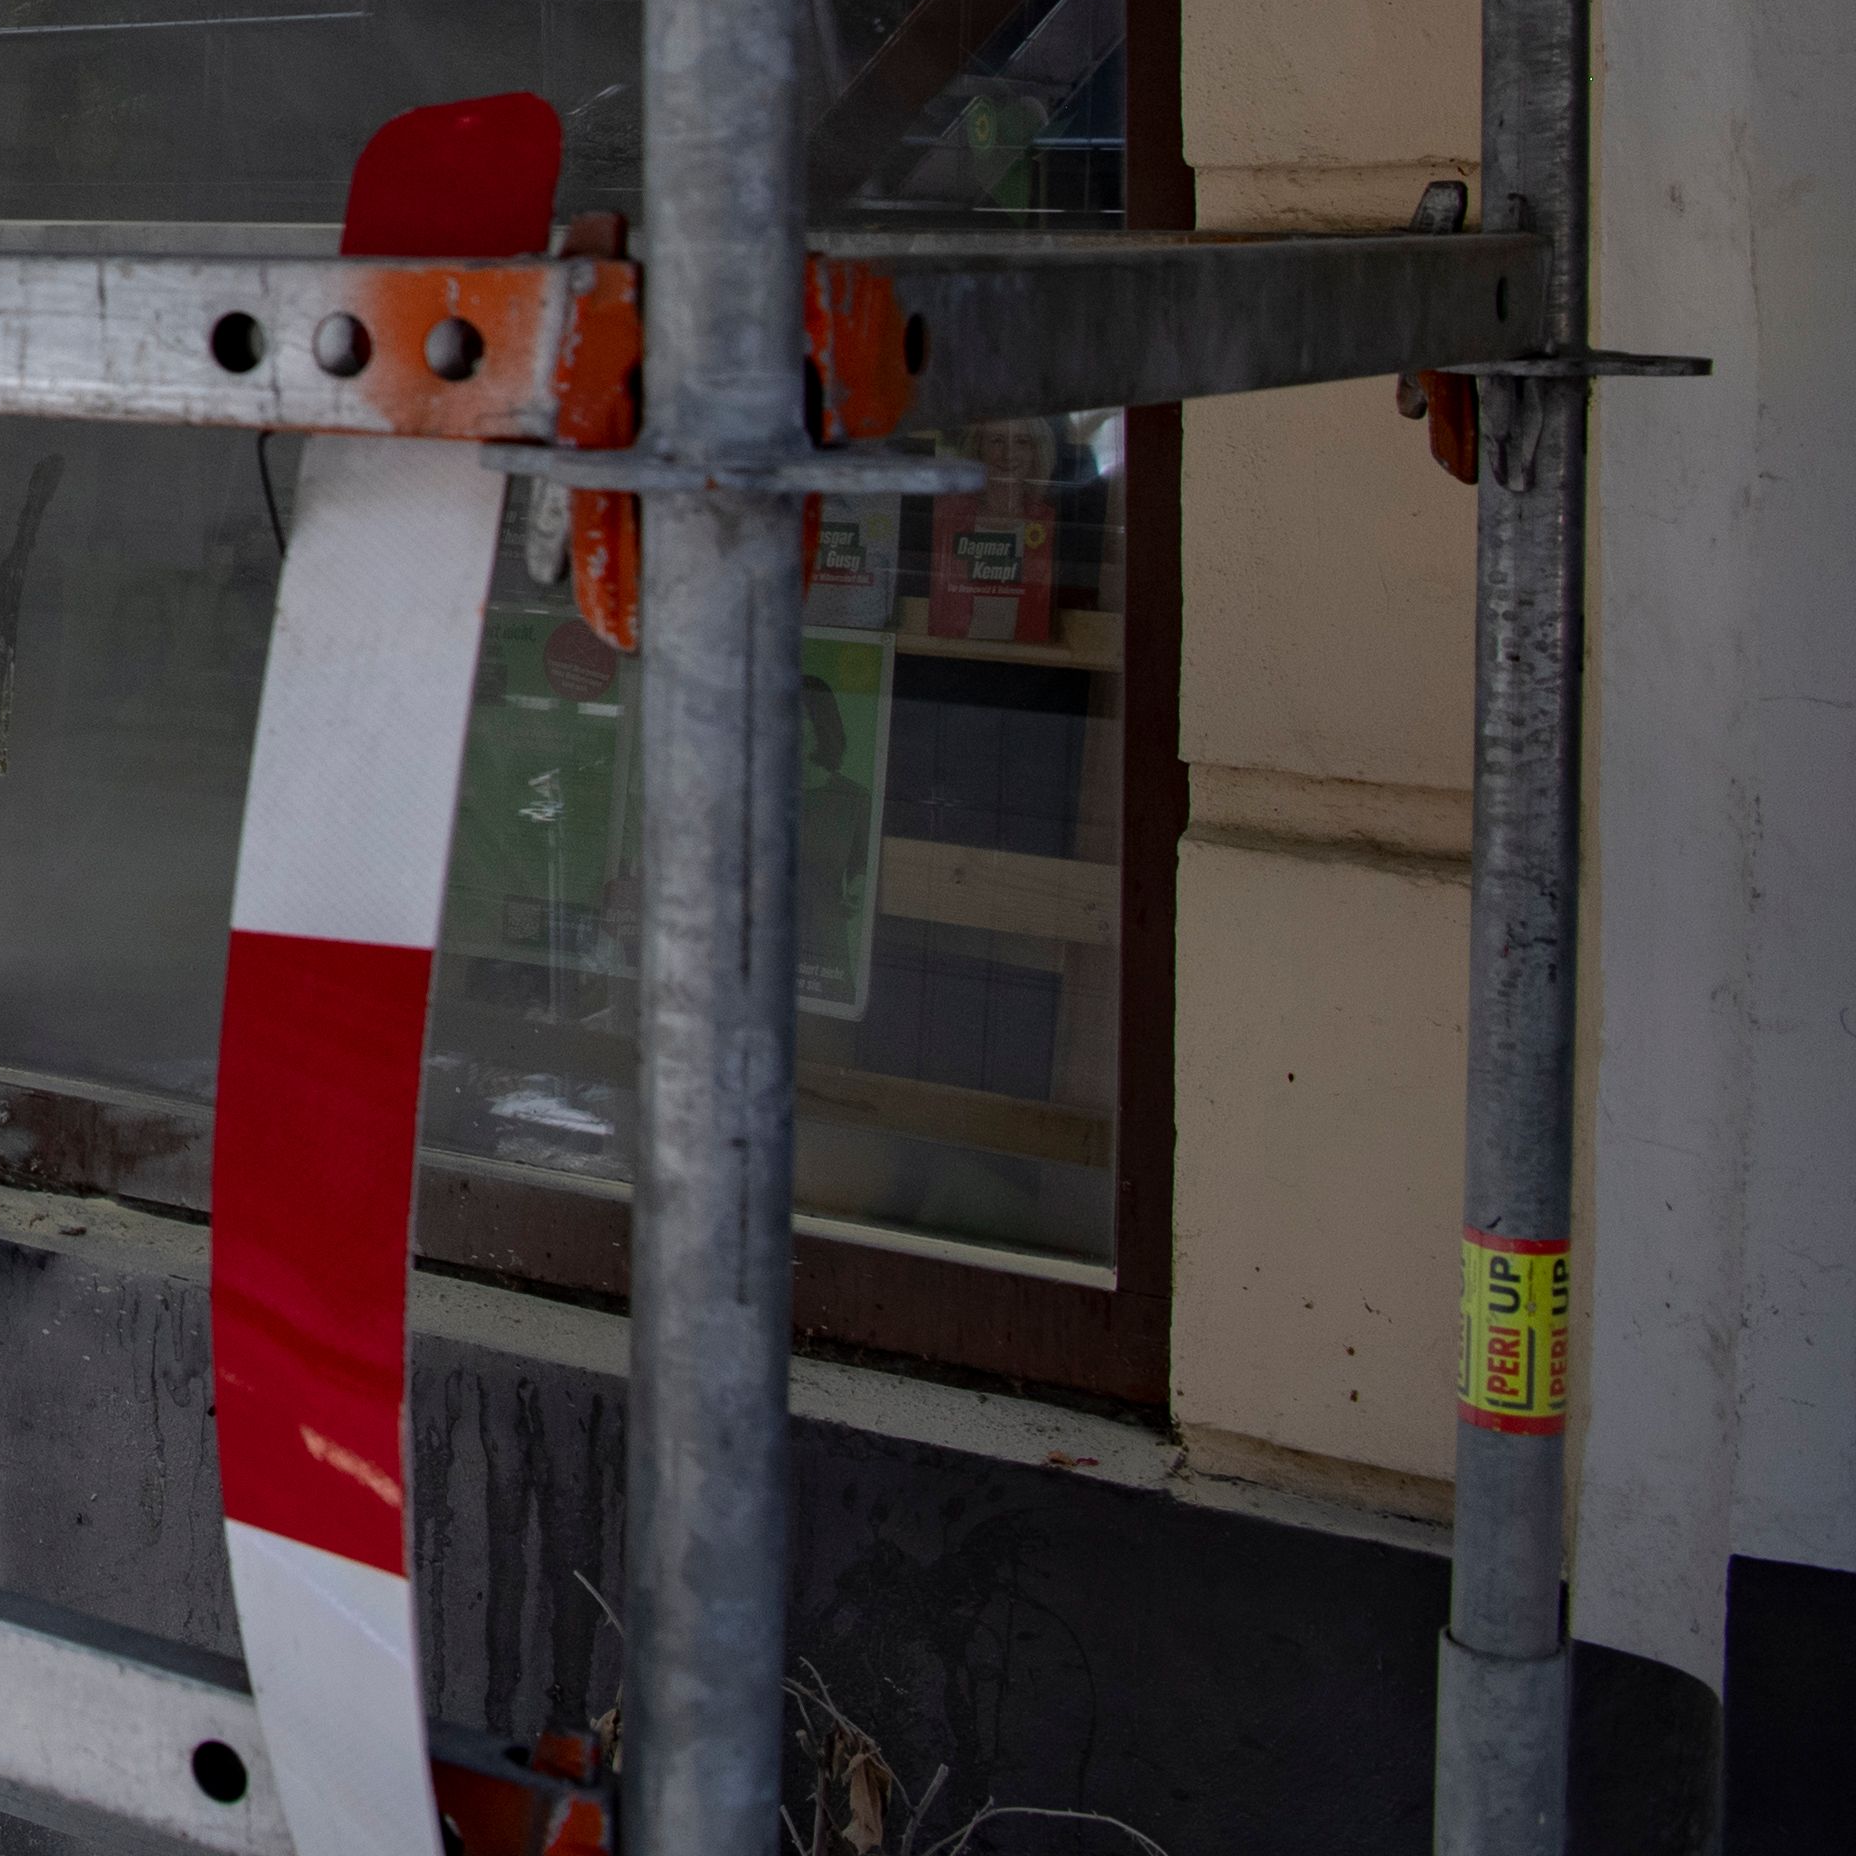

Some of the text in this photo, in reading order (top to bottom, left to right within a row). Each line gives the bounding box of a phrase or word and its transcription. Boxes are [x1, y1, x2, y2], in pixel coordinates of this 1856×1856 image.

[957, 536, 1012, 559] Dagmar
[826, 550, 861, 572] Gusy
[972, 561, 1018, 583] Kempf
[1487, 1255, 1521, 1397] PERI UP
